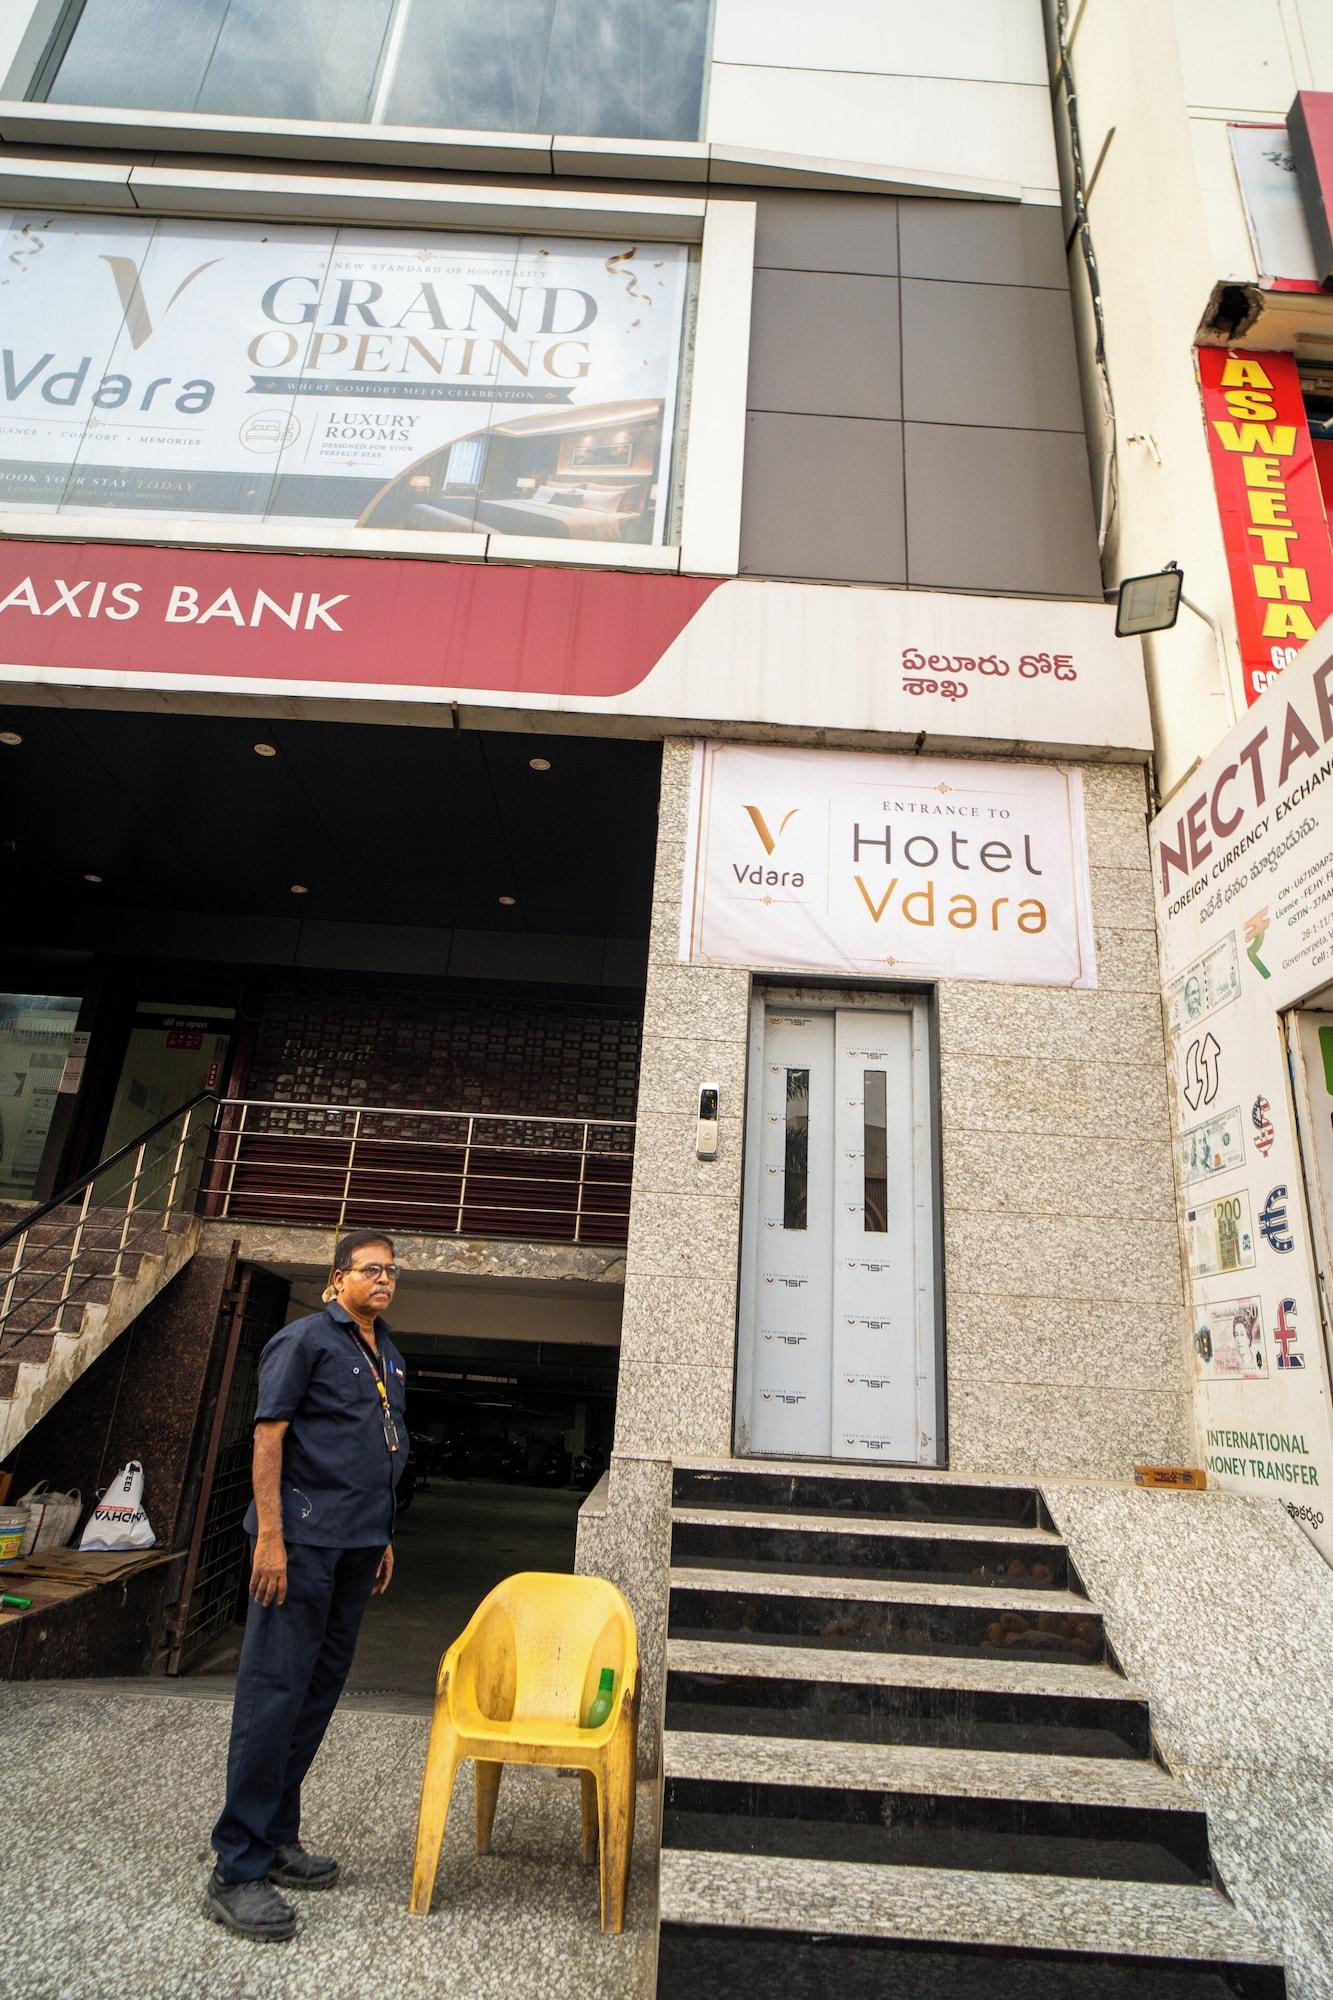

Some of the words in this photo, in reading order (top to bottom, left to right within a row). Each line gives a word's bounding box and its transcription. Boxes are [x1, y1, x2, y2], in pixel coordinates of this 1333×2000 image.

[371, 263, 441, 273] STANDARD
[446, 266, 462, 274] OF
[467, 267, 548, 278] HOSPITALITY
[261, 276, 598, 335] GRAND
[247, 330, 594, 379] OPENING
[1, 350, 215, 414] Vdara
[287, 383, 330, 392] WHERE
[335, 384, 398, 394] COMFORT
[403, 387, 444, 396] MEETS
[448, 389, 536, 399] CELEBRATION
[328, 412, 420, 427] LUXURY
[61, 431, 120, 441] COMFORT
[139, 437, 202, 446] MEMORIES
[321, 442, 367, 450] DESIGNED
[326, 426, 410, 441] ROOMS
[91, 478, 131, 488] STAY
[136, 480, 197, 492] TODAY
[0, 576, 143, 621] AXIS
[165, 586, 351, 632] BANK
[902, 648, 1010, 677] ఏలూరు
[1018, 652, 1078, 681] రోడ్
[882, 800, 980, 818] ENTRANCE
[989, 808, 1011, 820] TO
[853, 822, 1042, 876] Hotel
[1168, 874, 1209, 920] FOREIGN
[1211, 816, 1270, 879] CURRENCY
[1275, 757, 1333, 822] EXCHAN
[733, 863, 805, 888] Vdara
[854, 875, 1047, 935] Vdara
[1278, 885, 1290, 900] CIN
[1275, 898, 1299, 919] Licence
[1288, 906, 1308, 927] GSTIN
[1313, 887, 1333, 909] 37AA
[1207, 1429, 1309, 1454] INTERNATIONAL
[123, 1471, 134, 1492] FEED
[1205, 1455, 1247, 1476] MONEY
[1249, 1459, 1319, 1486] TRANSFER
